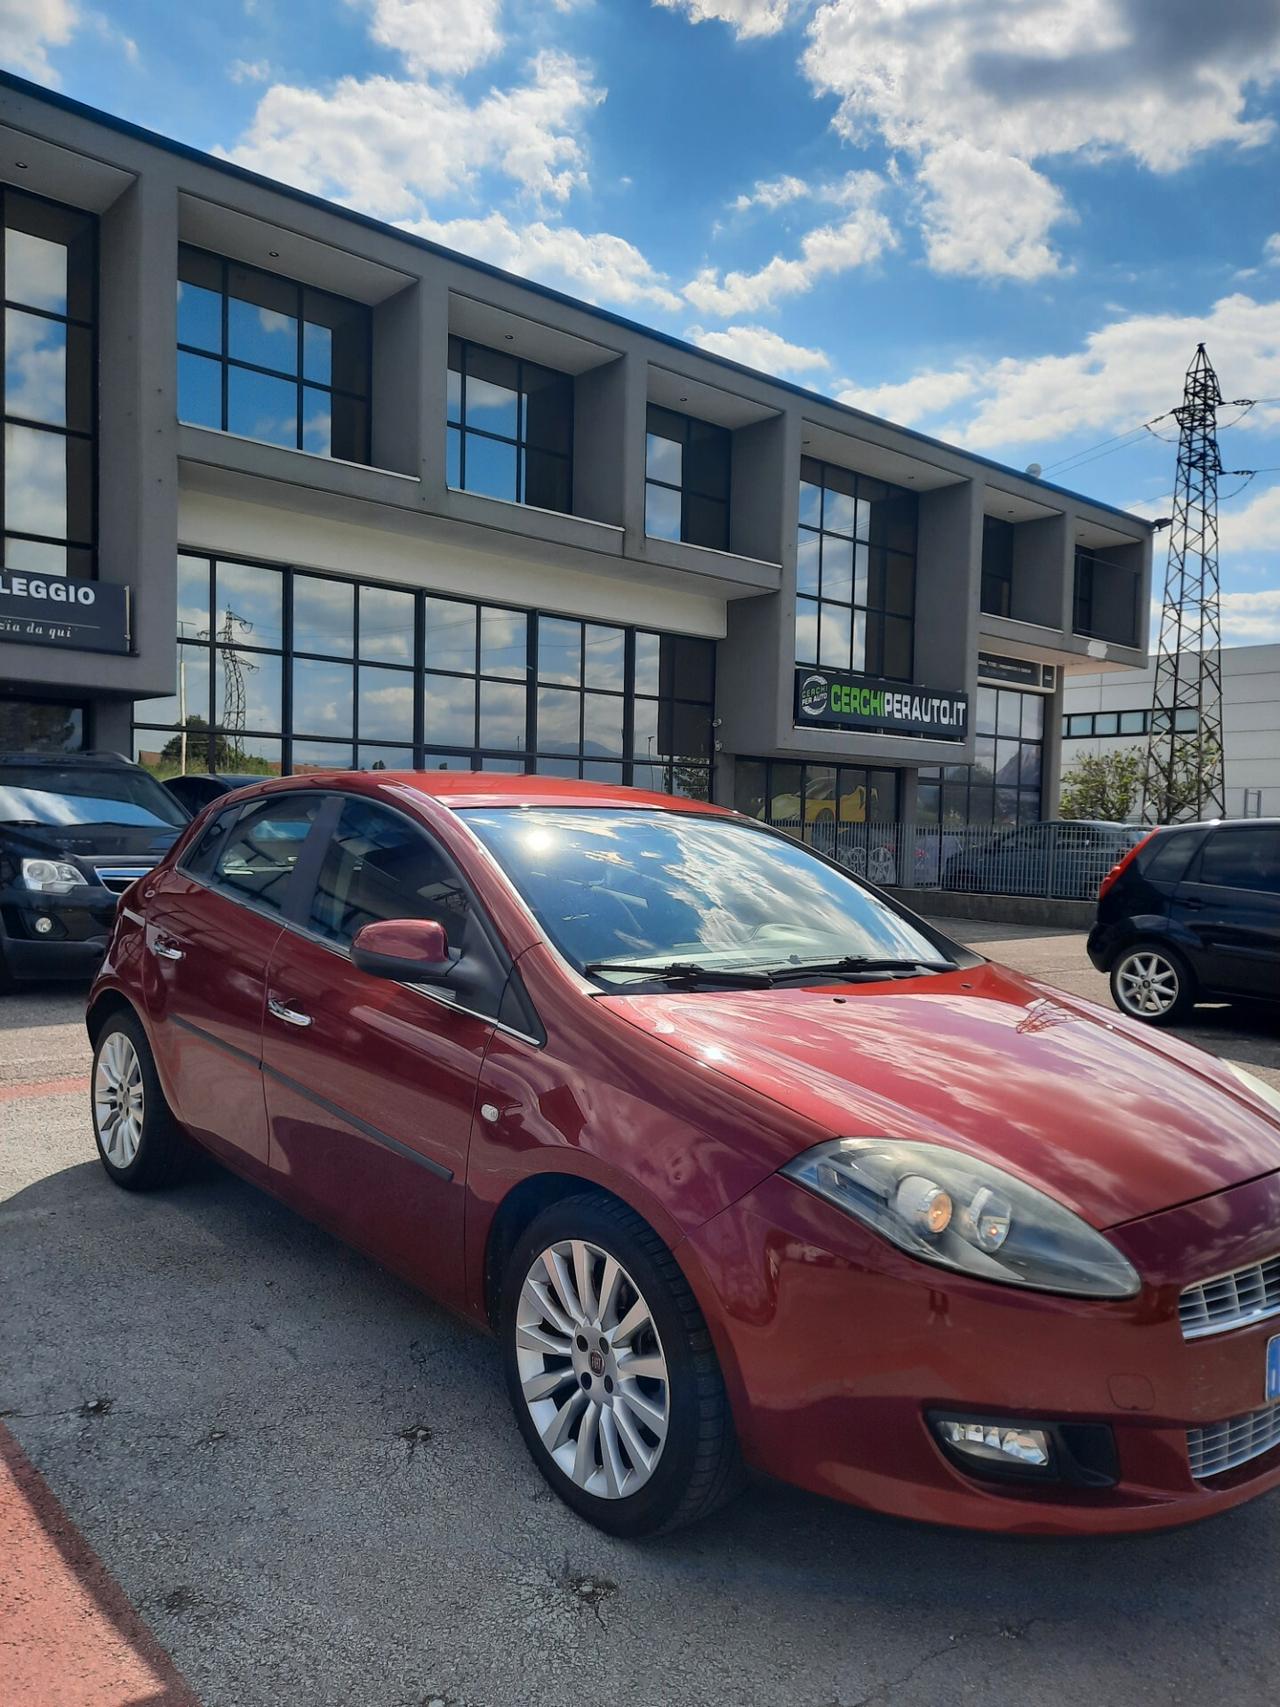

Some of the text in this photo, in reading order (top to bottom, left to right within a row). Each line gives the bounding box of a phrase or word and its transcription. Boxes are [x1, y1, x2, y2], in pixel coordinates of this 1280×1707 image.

[26, 622, 43, 634] da
[49, 627, 71, 640] qui
[802, 685, 828, 699] CERCHI
